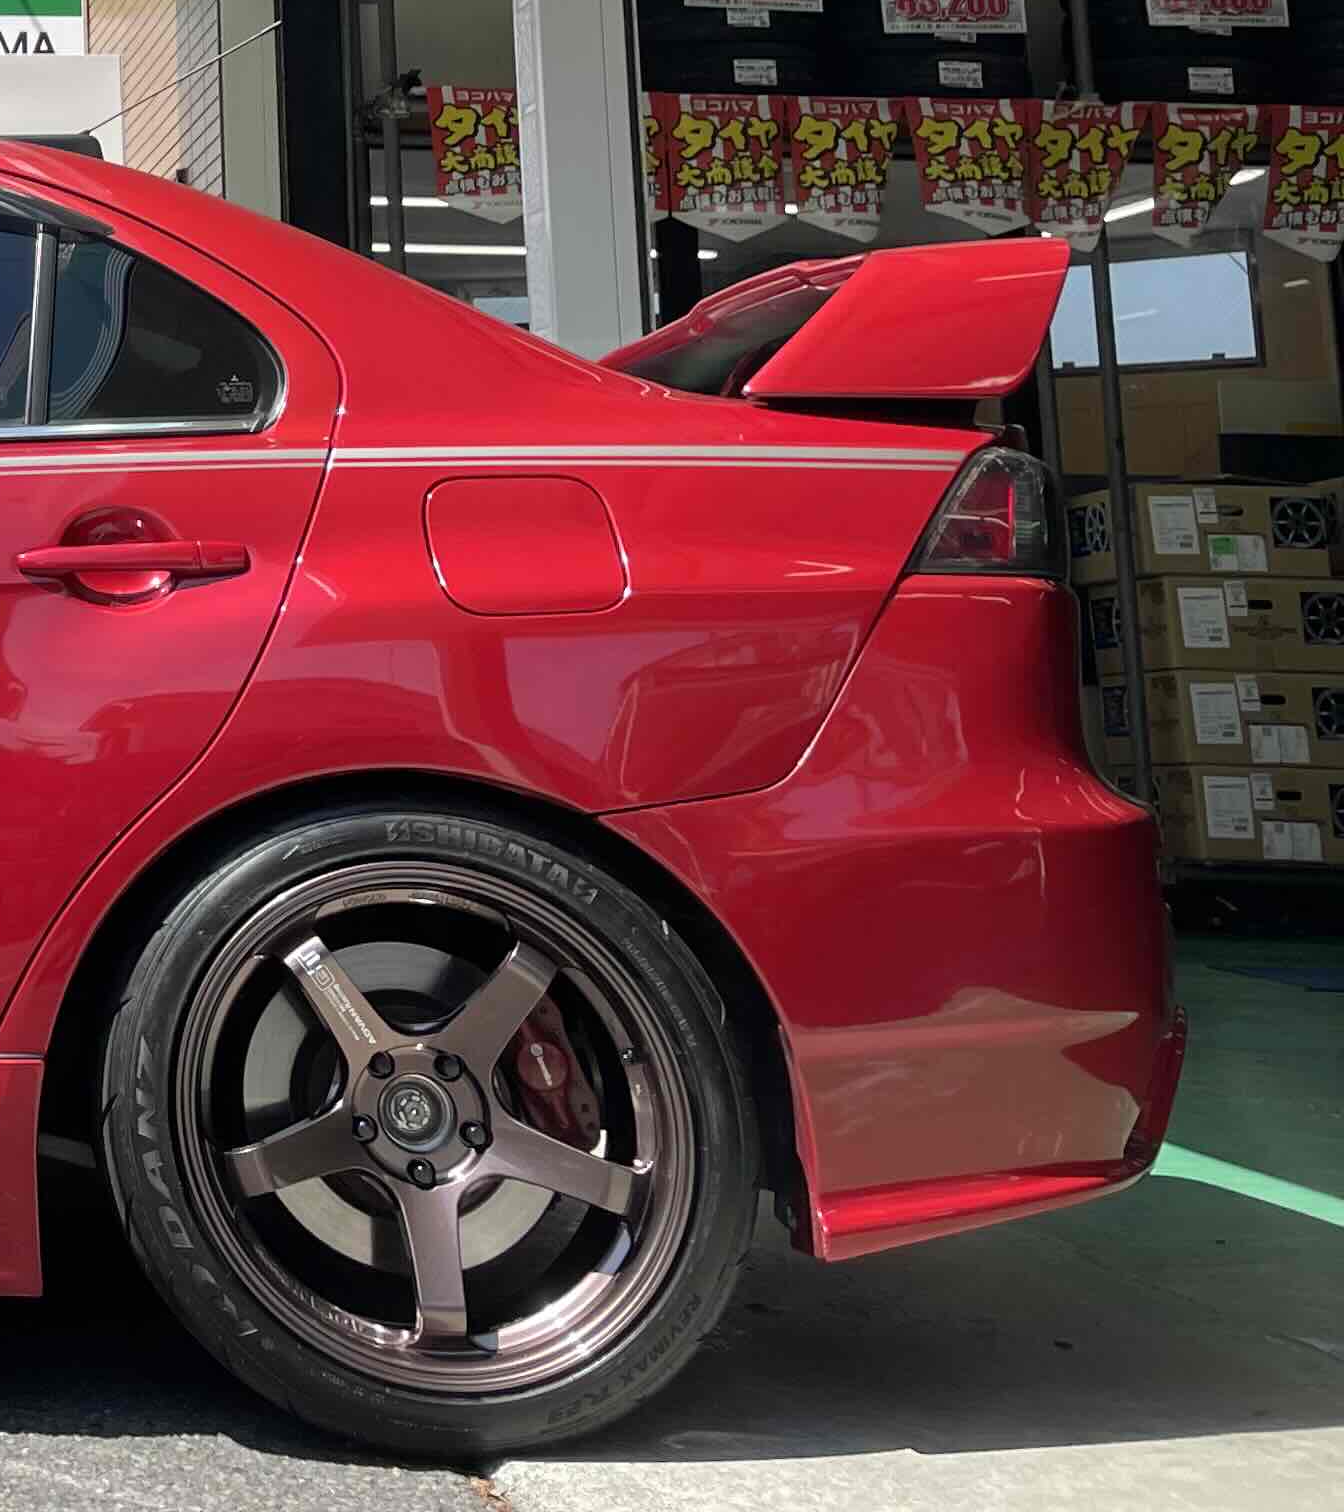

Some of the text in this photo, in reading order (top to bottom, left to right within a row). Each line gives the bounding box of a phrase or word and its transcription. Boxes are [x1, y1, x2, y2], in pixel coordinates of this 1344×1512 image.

[455, 90, 514, 104] ヨコハマ
[692, 98, 754, 113] ヨコハマ
[812, 101, 874, 116] ヨコハマ
[672, 112, 779, 159] タイヤ
[793, 114, 899, 160] タイヤ
[915, 117, 1025, 155] タイヤ
[1034, 120, 1142, 168] タイヤ
[1158, 123, 1259, 172] タイヤ
[799, 156, 892, 188] 大商談
